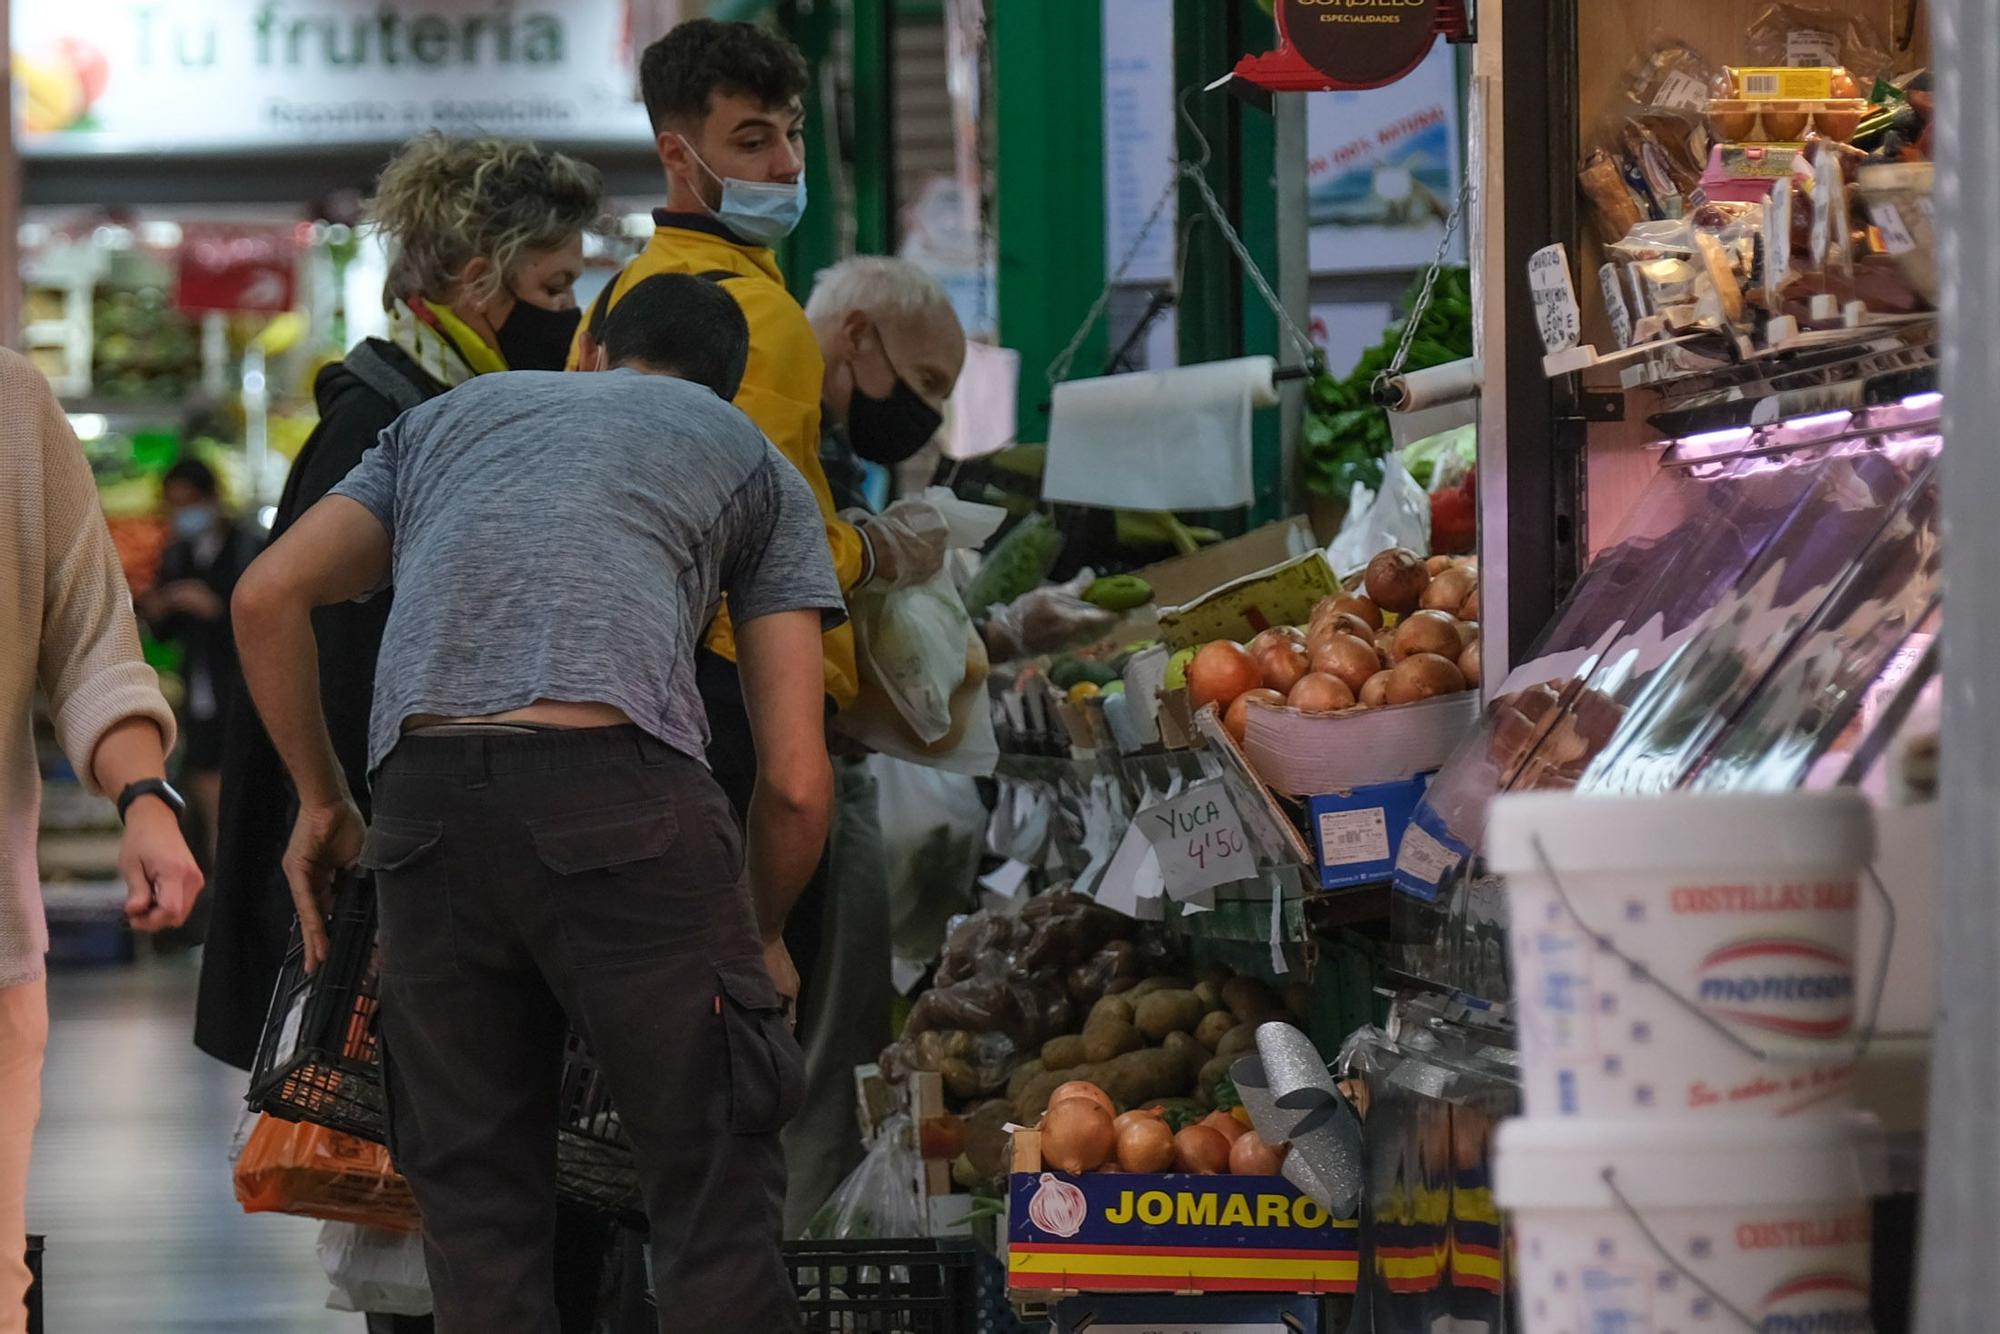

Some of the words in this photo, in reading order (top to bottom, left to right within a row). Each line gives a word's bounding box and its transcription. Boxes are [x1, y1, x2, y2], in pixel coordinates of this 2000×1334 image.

[130, 8, 217, 66] Tu
[1320, 14, 1400, 23] ESPECIALIDADES
[1155, 801, 1219, 839] YUCA
